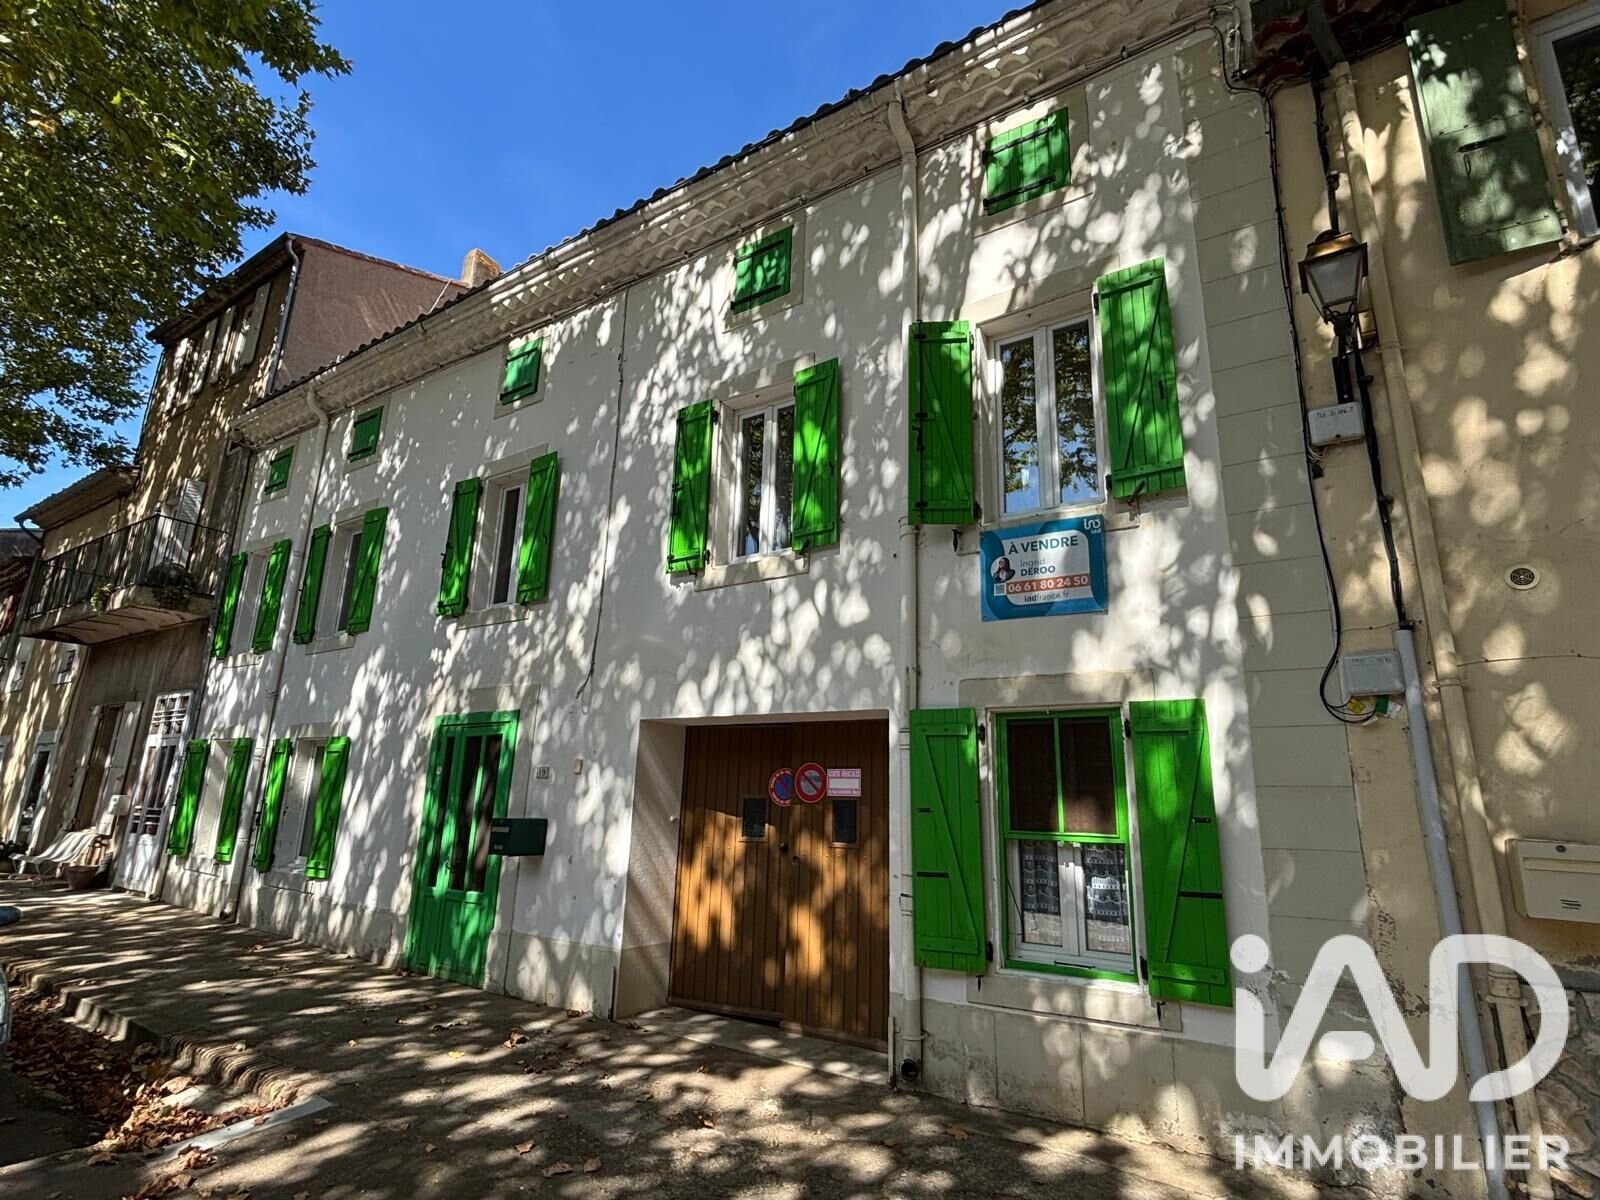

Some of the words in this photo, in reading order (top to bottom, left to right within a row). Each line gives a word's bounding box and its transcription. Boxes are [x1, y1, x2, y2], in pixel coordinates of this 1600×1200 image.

[1020, 535, 1079, 553] VENDRE
[1020, 557, 1046, 569] Ingrid
[1020, 565, 1056, 577] DEROO
[1008, 583, 1022, 593] 06
[1024, 581, 1037, 591] 61
[1040, 579, 1055, 590] 80
[1056, 577, 1071, 588] 24
[1074, 575, 1088, 586] 50
